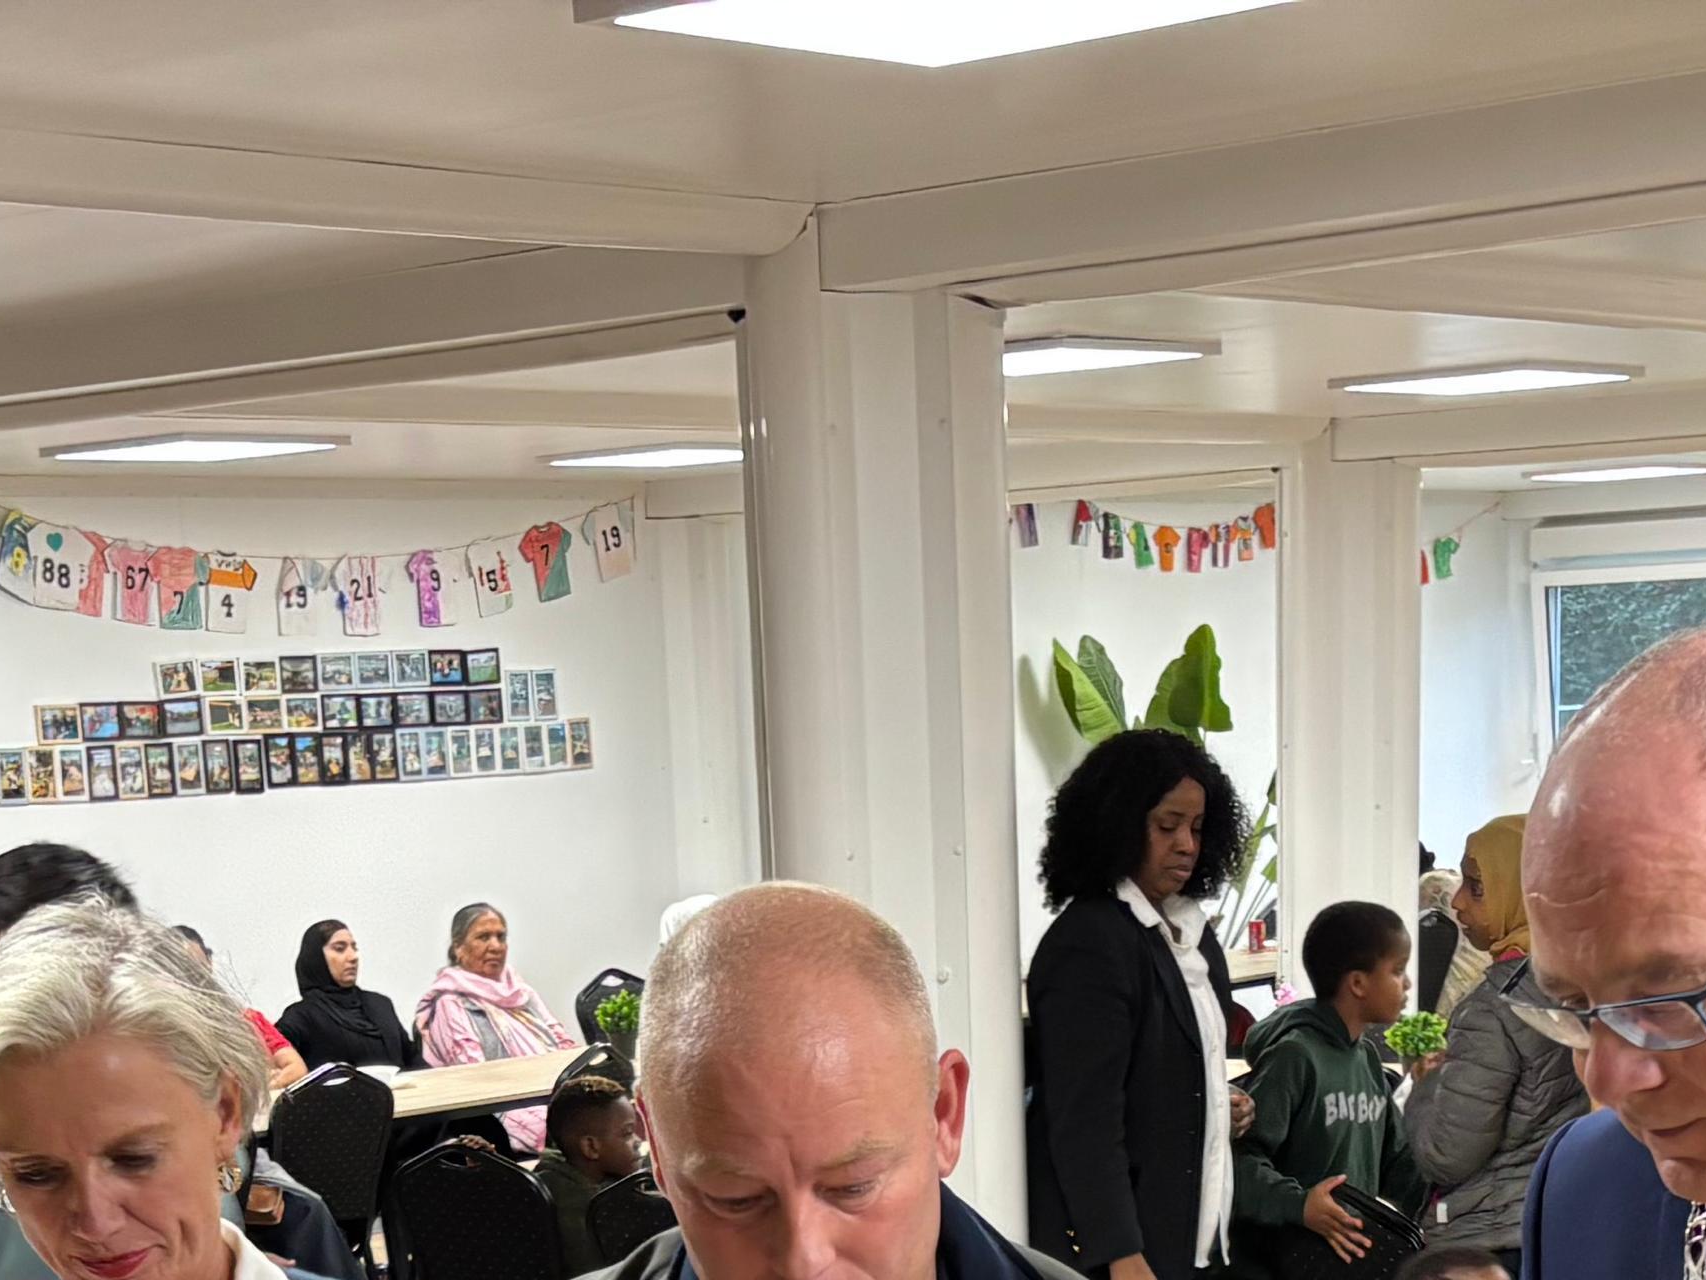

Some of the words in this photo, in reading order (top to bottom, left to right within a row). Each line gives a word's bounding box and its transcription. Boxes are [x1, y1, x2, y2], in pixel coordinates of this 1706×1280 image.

[602, 526, 621, 552] 19
[541, 544, 549, 566] 7
[42, 558, 70, 589] 88
[125, 565, 149, 591] 67
[430, 569, 441, 592] 9
[284, 585, 307, 608] 19
[351, 576, 373, 601] 21
[173, 591, 184, 615] 7
[221, 593, 234, 618] 4
